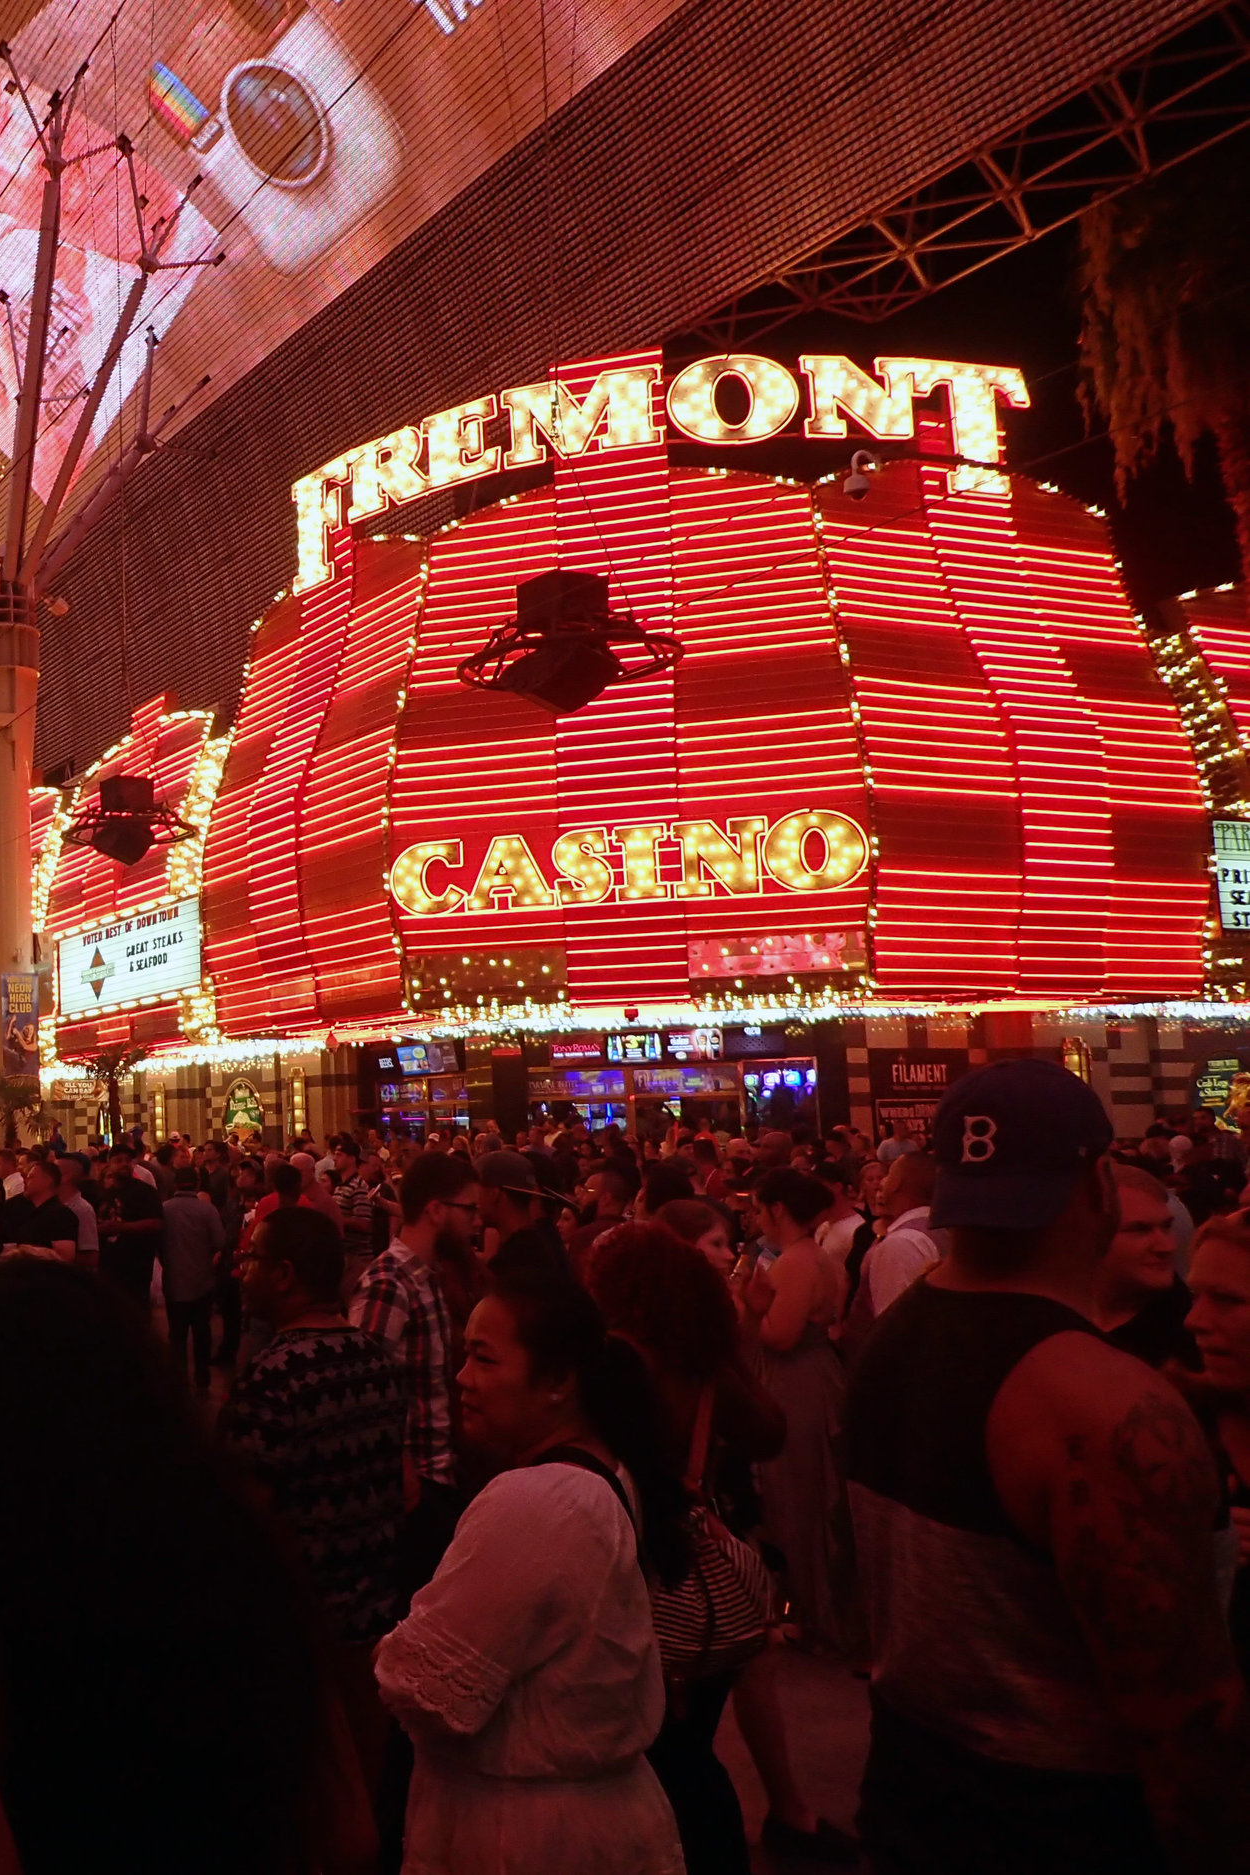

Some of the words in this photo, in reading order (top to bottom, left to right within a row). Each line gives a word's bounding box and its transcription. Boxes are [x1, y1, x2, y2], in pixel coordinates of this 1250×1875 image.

[291, 353, 1031, 597] FREMONT
[390, 808, 870, 916] CASINO
[83, 931, 103, 947] VOTED
[106, 924, 122, 940] BEST
[125, 919, 134, 933] OF
[137, 905, 179, 930] DOWNTOWN
[126, 940, 149, 957] GREAT
[153, 930, 183, 950] STEAKS
[136, 952, 168, 971] SEAFOOD
[8, 983, 33, 993] NEON
[9, 993, 31, 1003] HIGH
[8, 1003, 33, 1013] CLUB
[892, 1064, 947, 1082] FILAMENT
[960, 1115, 998, 1164] B
